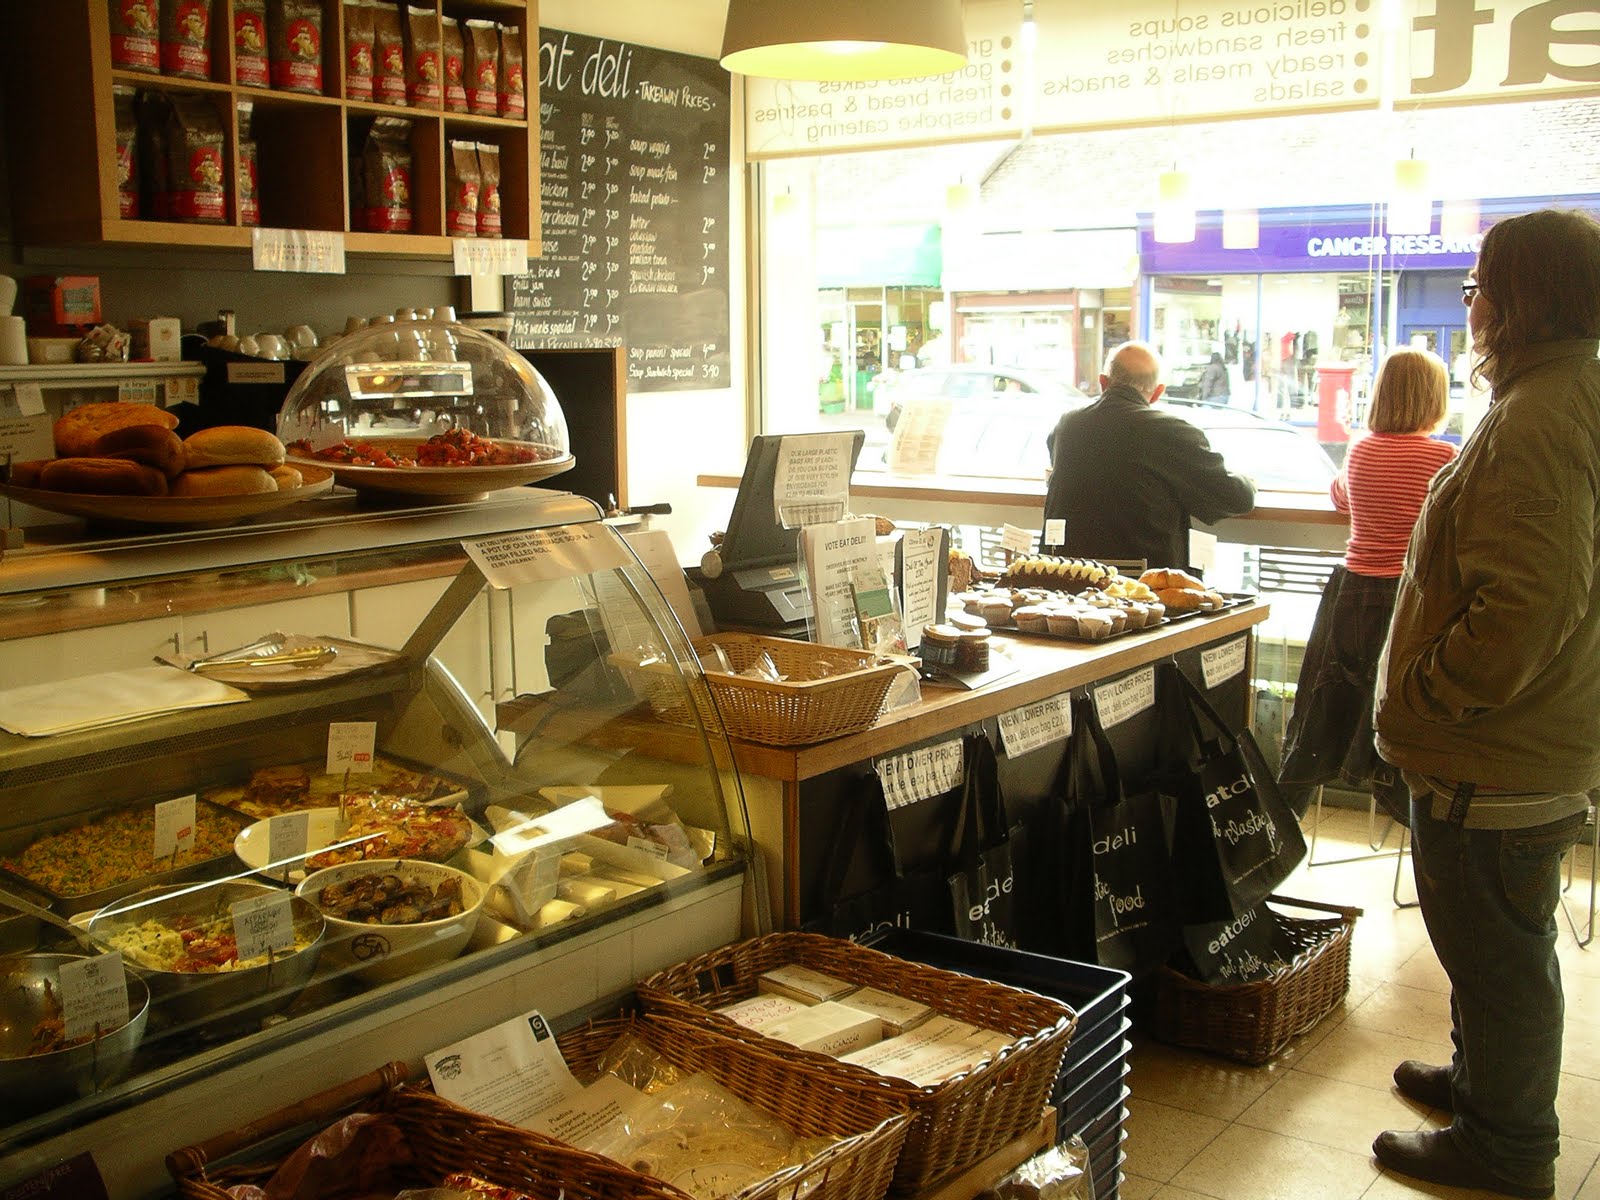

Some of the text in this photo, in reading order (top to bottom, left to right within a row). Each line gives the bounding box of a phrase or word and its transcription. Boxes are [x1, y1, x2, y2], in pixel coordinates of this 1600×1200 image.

[581, 40, 633, 99] deli
[639, 81, 679, 108] TAKEAWAY
[1307, 235, 1387, 258] CANCER
[485, 551, 510, 563] FRESH
[510, 546, 534, 559] FILLED
[487, 545, 501, 554] POT
[502, 543, 512, 552] OF
[513, 541, 528, 550] OUR
[825, 539, 839, 551] VOTE
[839, 537, 850, 549] EAT
[1097, 688, 1115, 702] NEW
[1114, 679, 1135, 696] LOWER
[1000, 712, 1020, 729] NEW
[1021, 705, 1045, 722] LOWER
[1108, 883, 1144, 928] food
[1208, 908, 1258, 955] eatdeli
